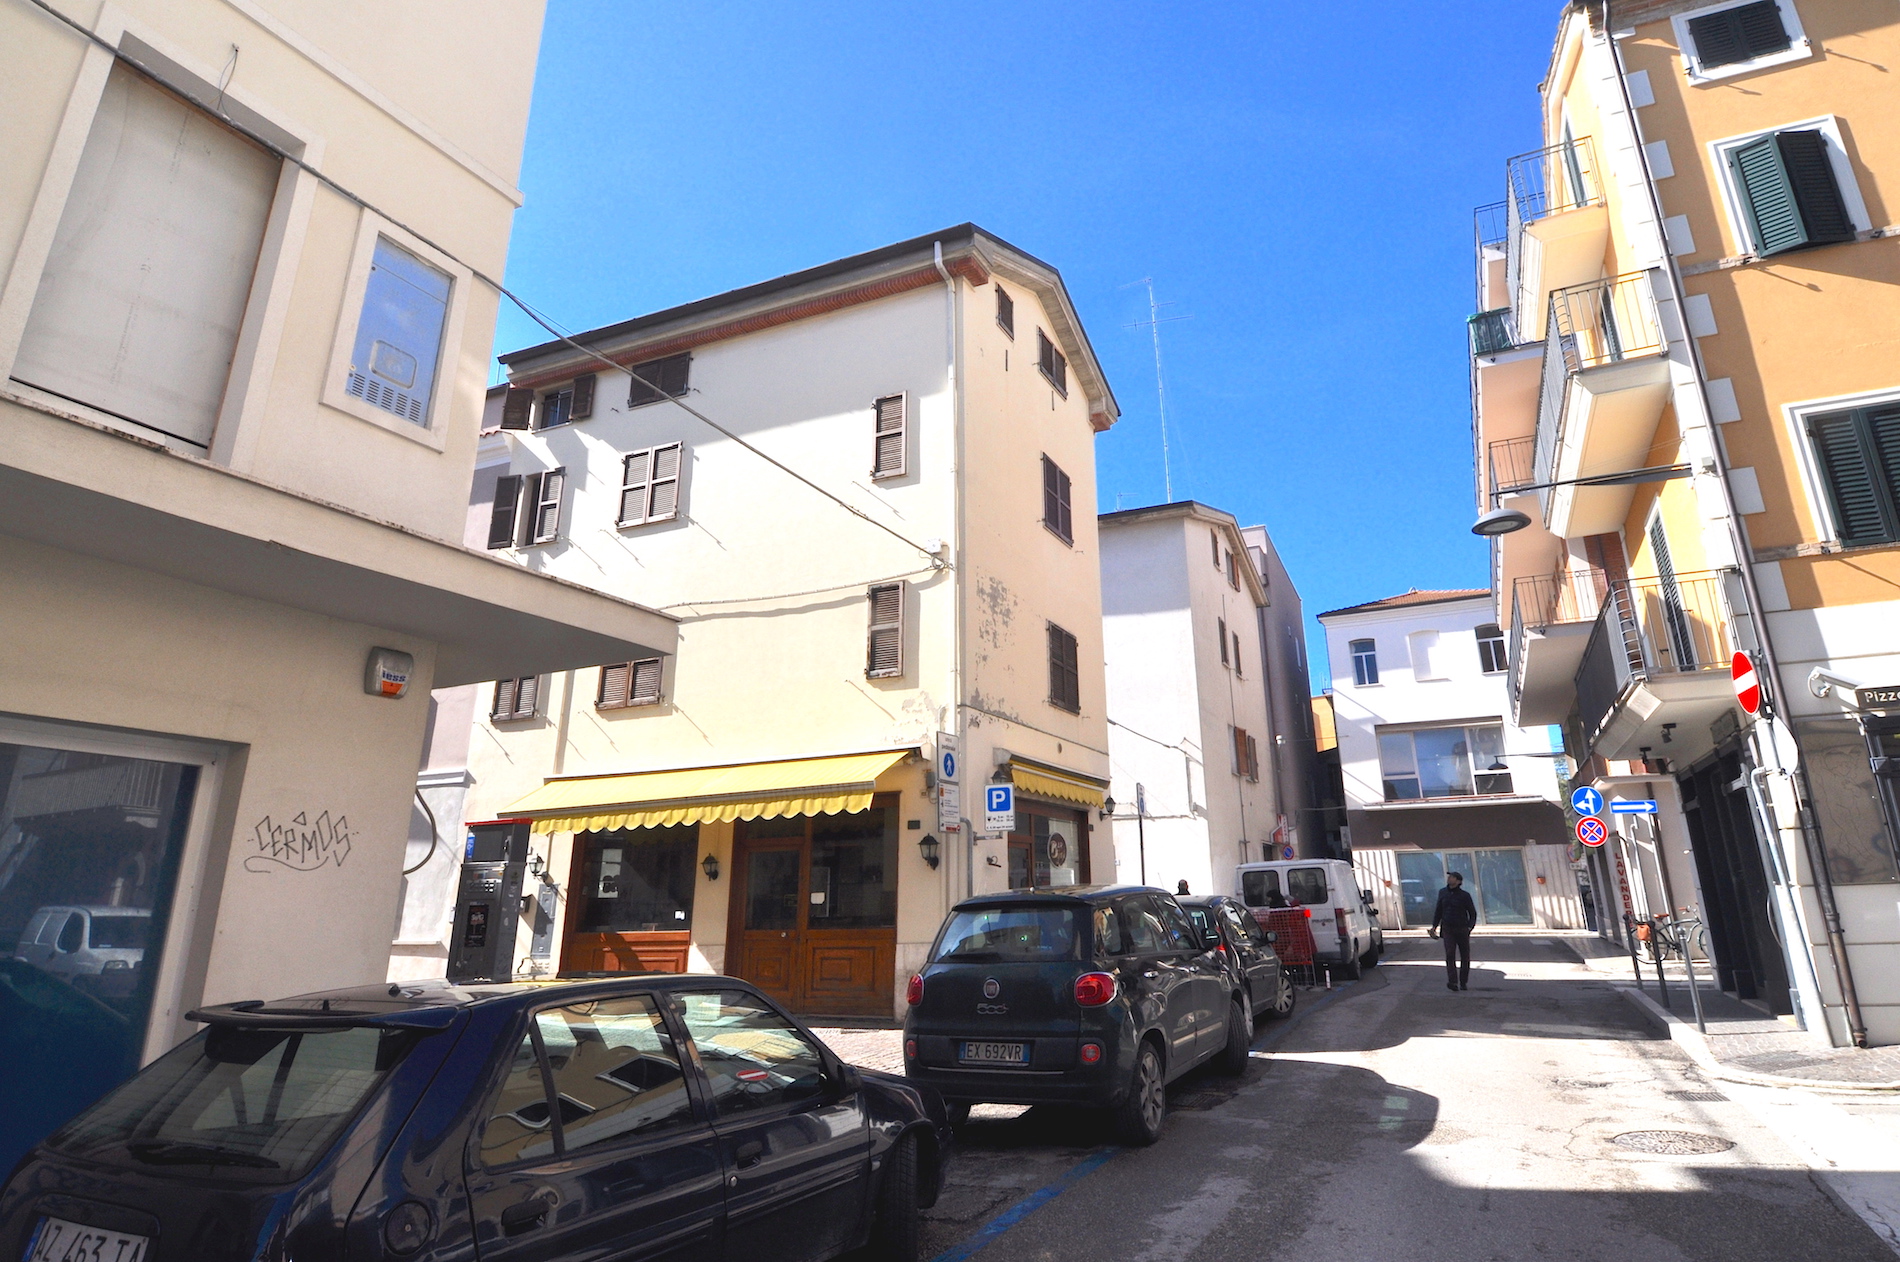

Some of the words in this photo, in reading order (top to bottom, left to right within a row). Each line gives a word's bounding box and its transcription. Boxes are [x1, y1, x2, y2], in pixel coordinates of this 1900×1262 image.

[992, 790, 1006, 809] P
[966, 1043, 981, 1059] EX
[33, 1222, 64, 1262] AZ
